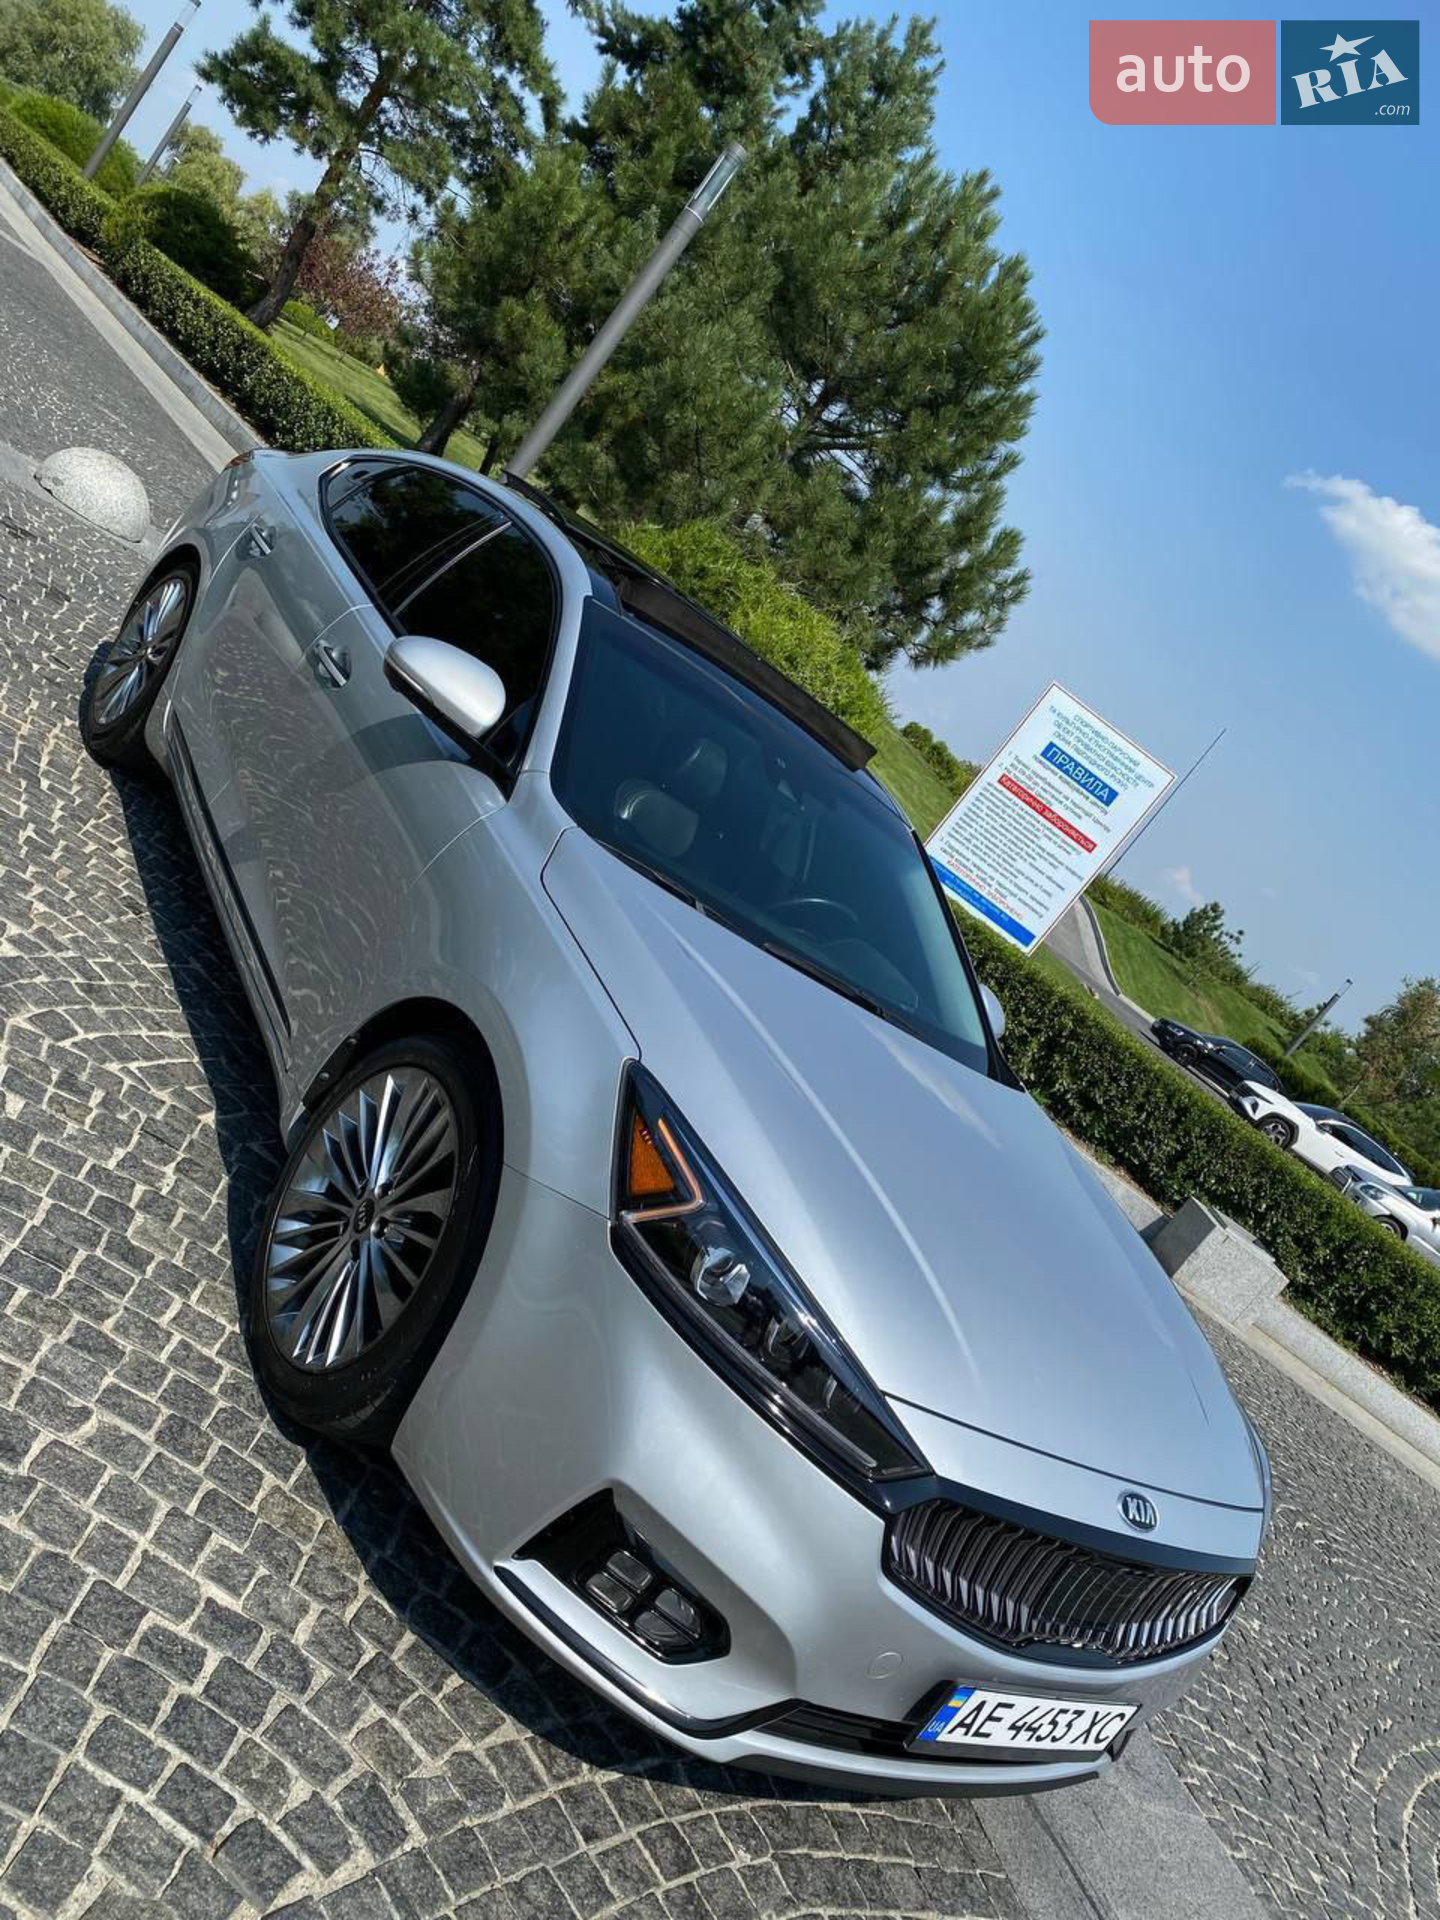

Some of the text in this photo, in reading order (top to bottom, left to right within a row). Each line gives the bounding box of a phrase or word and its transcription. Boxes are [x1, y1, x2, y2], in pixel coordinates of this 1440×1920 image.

[1045, 746, 1112, 801] ПРАВИЛА
[999, 775, 1045, 812] Категорично
[1041, 807, 1095, 850] забороняється
[1126, 1497, 1155, 1525] KIA
[948, 1701, 1126, 1744] AE 4453 XC
